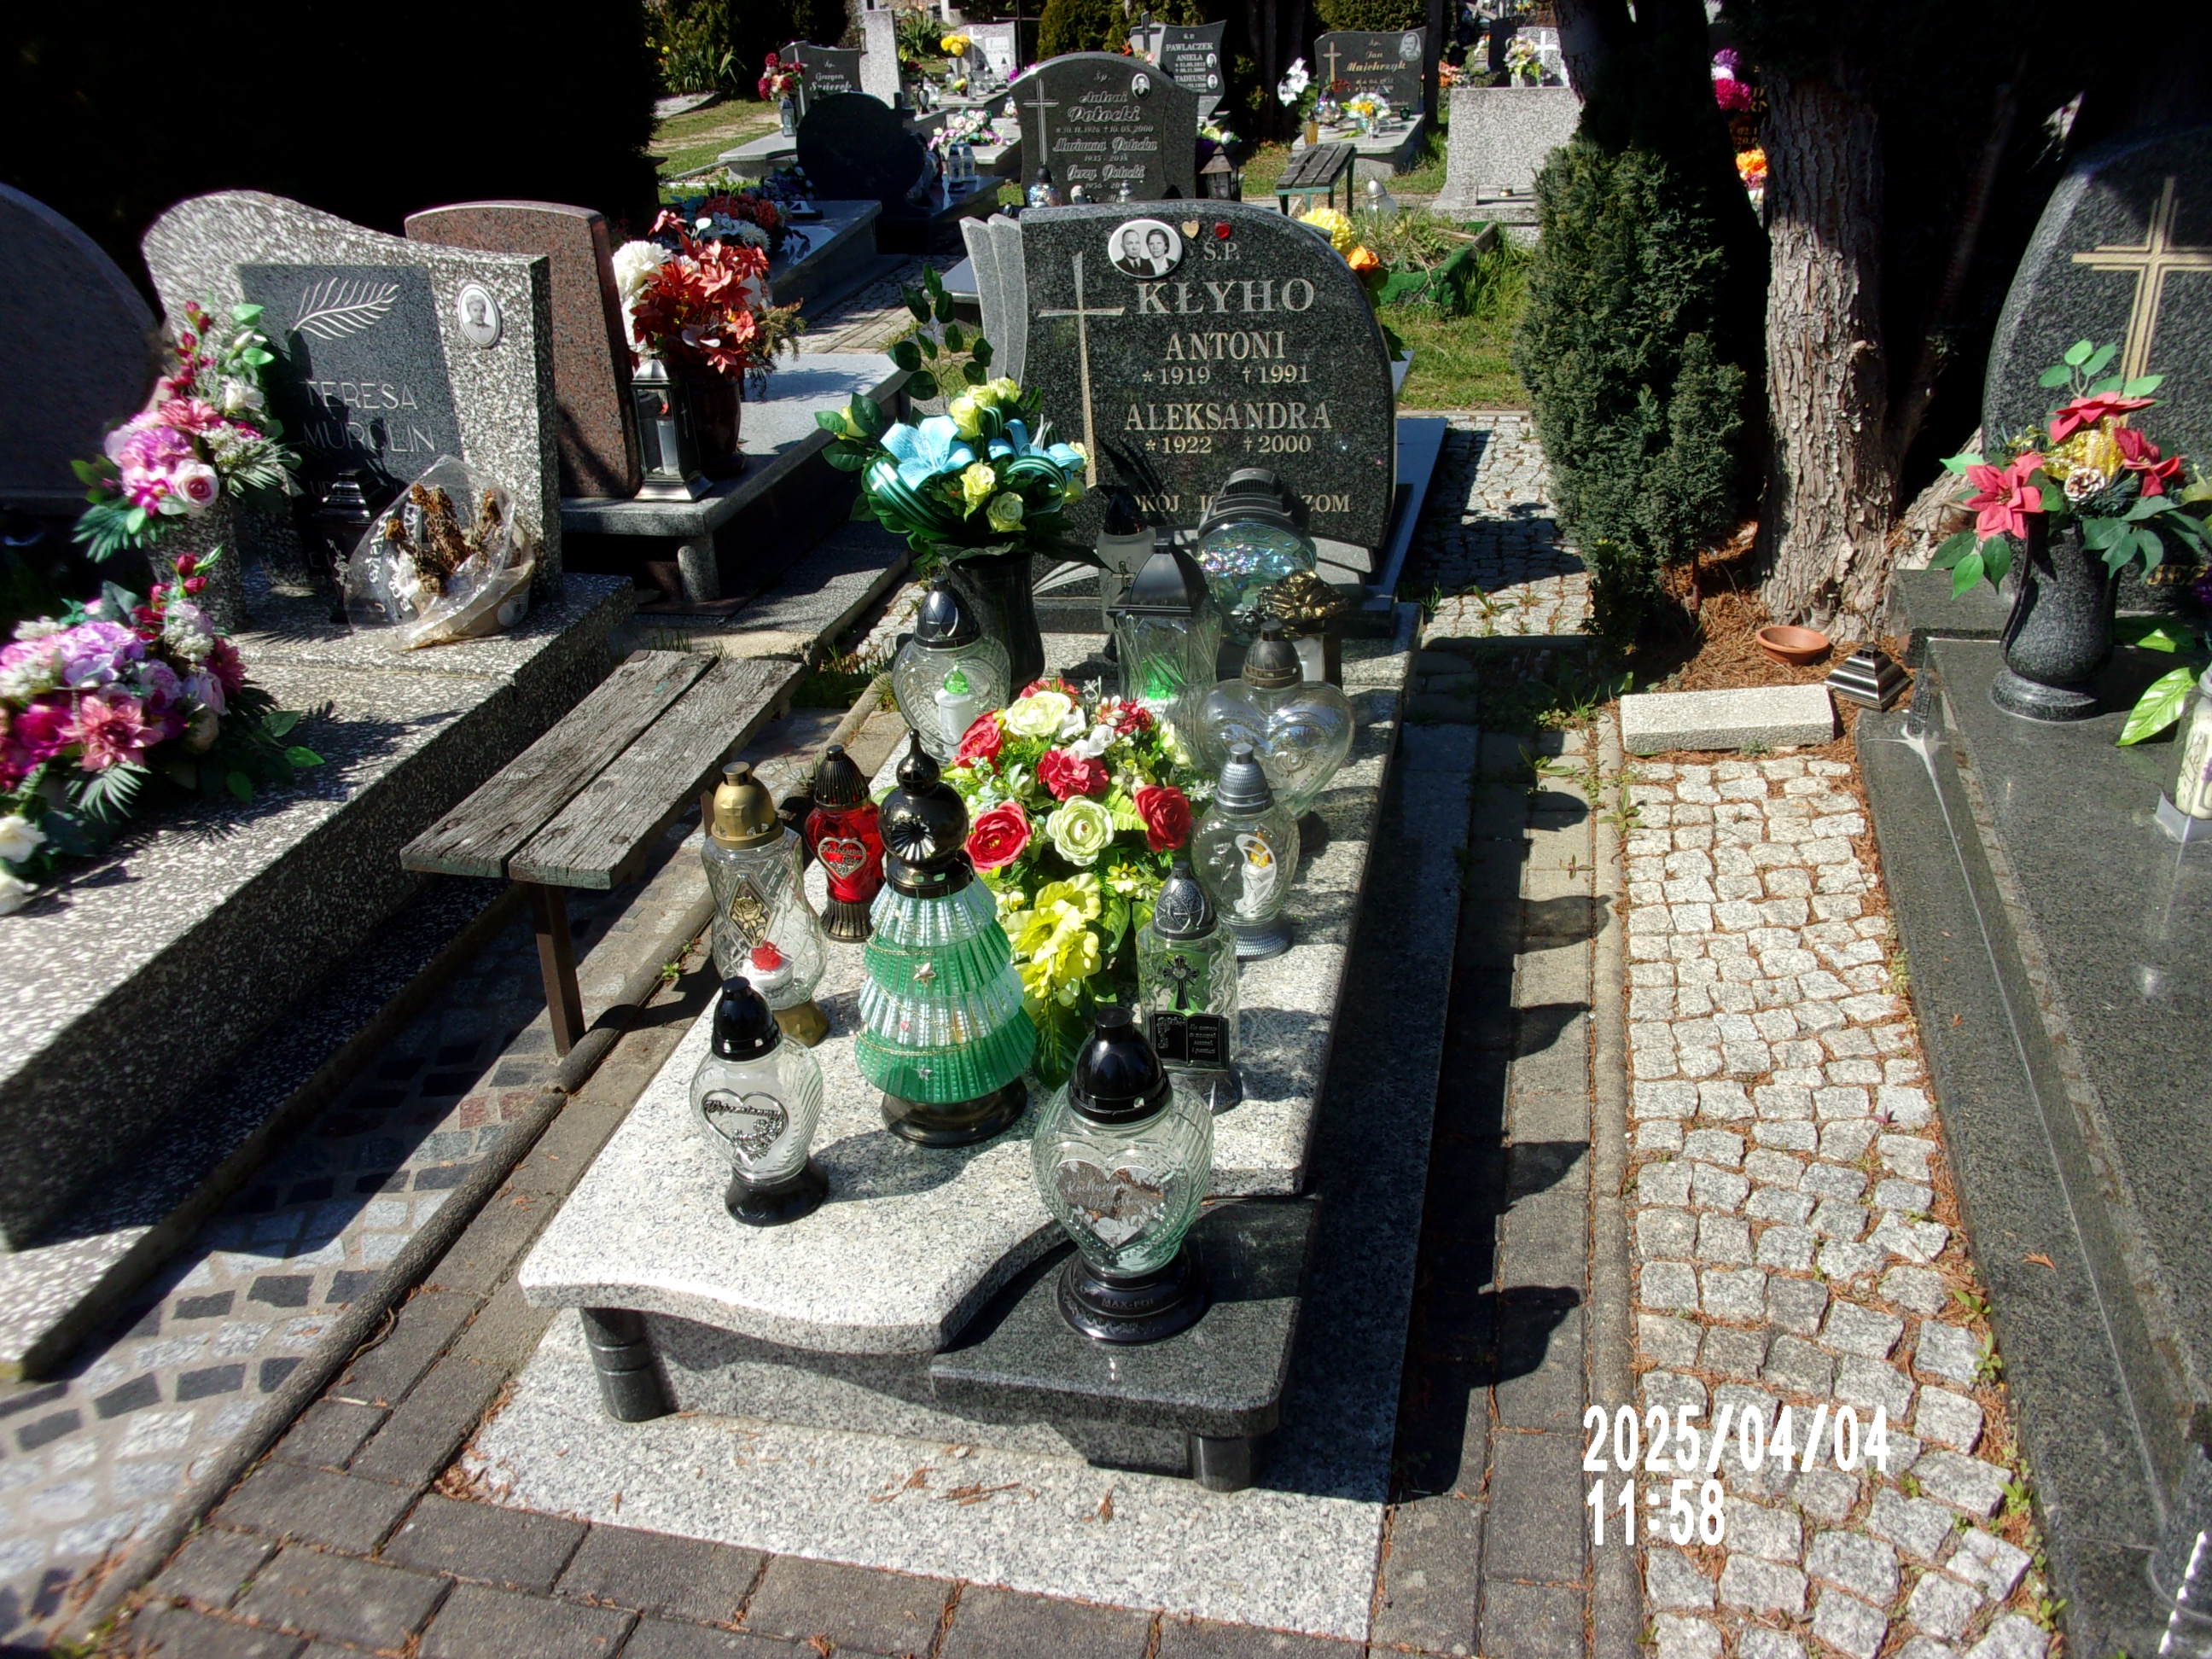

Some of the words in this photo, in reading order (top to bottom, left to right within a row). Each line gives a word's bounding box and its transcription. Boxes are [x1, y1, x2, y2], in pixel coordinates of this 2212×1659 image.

[1079, 90, 1128, 103] Antoni
[1068, 105, 1141, 123] Potocki
[1052, 137, 1107, 152] Marianna
[1112, 137, 1158, 154] Potocka
[1067, 164, 1097, 182] Jerzy
[1102, 164, 1146, 182] Potocki
[1137, 277, 1315, 315] KŁYHO
[1165, 331, 1285, 361] ANTONI
[308, 381, 418, 411] TERESA
[1125, 402, 1331, 431] ALEKSANDRA
